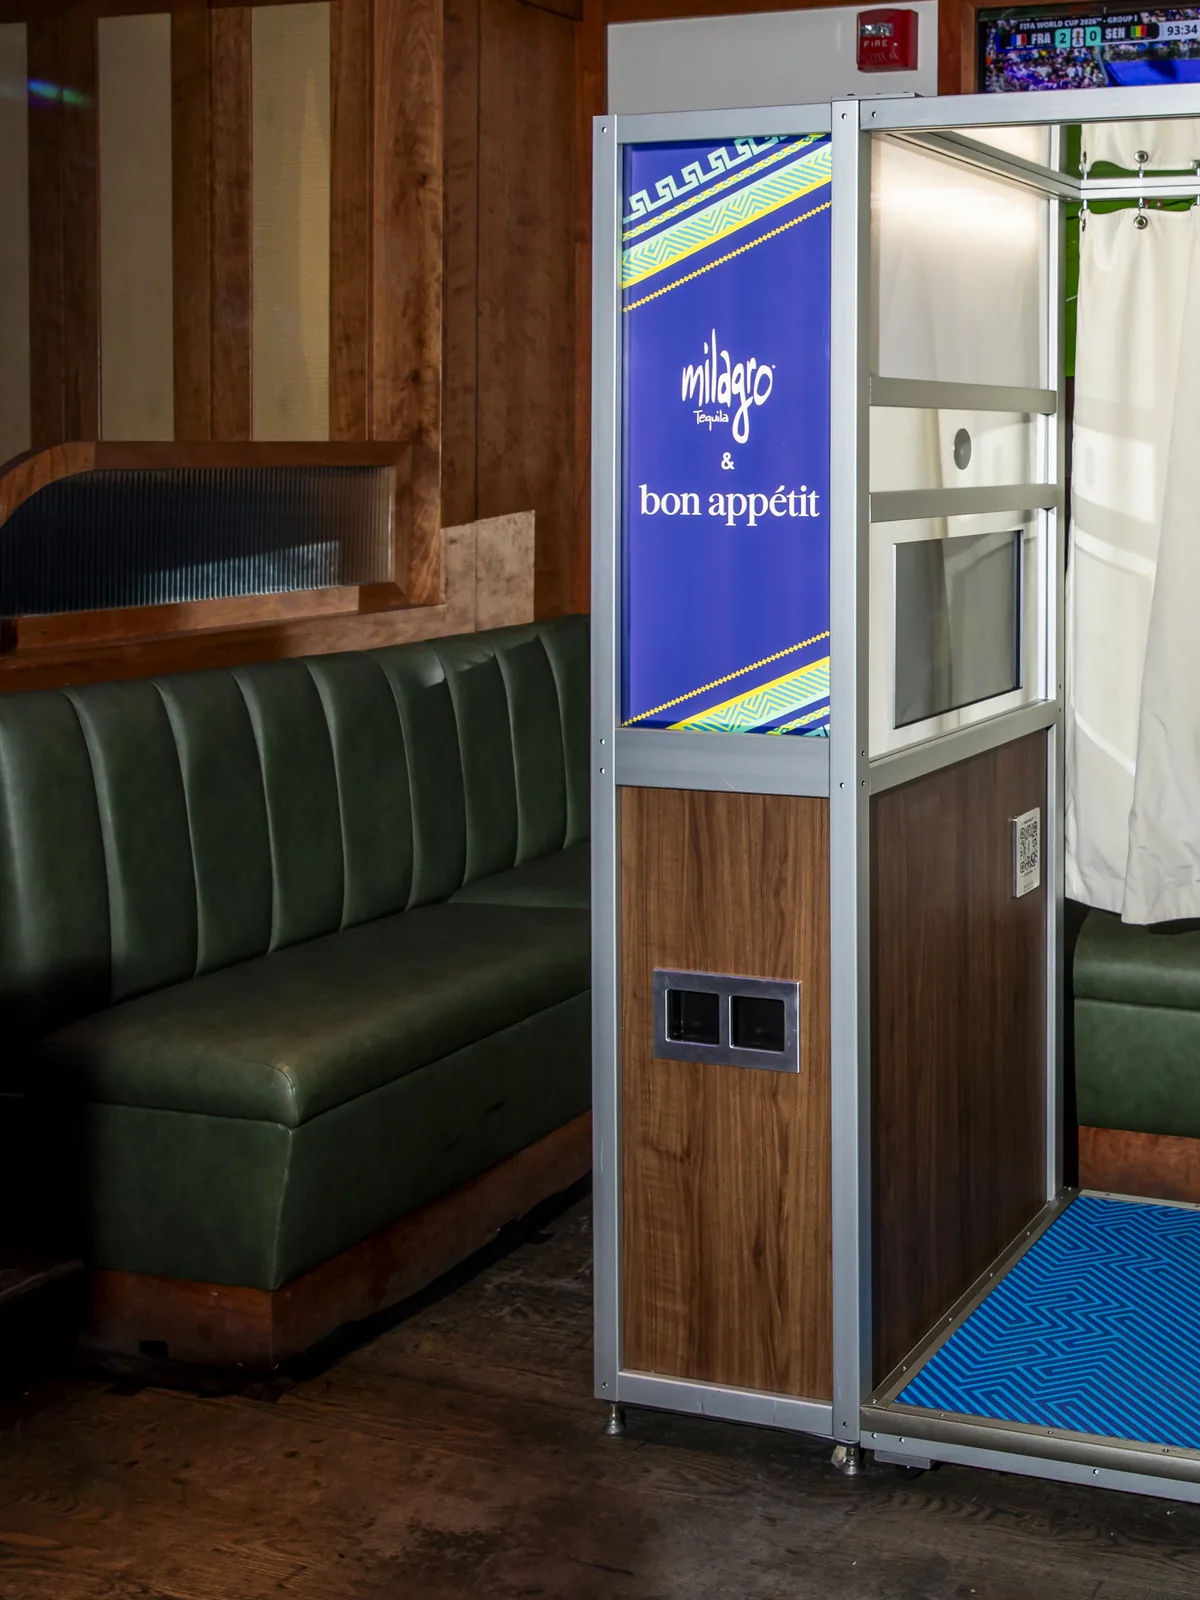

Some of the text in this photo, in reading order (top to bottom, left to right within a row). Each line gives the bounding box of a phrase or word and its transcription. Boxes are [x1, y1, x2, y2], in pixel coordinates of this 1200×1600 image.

[1020, 22, 1036, 30] FIFA
[1036, 20, 1063, 29] WORLD
[1064, 19, 1080, 27] CUP
[1107, 15, 1133, 24] GROUP
[863, 40, 888, 48] FIRE
[1031, 32, 1051, 45] FRA
[1060, 33, 1066, 43] 2
[1090, 31, 1097, 41] 0
[1105, 27, 1125, 39] SEN
[1167, 24, 1198, 36] 93:34
[681, 328, 773, 444] milagro
[693, 410, 729, 431] Tequila
[721, 452, 735, 470] &
[638, 484, 820, 526] bon appétit
